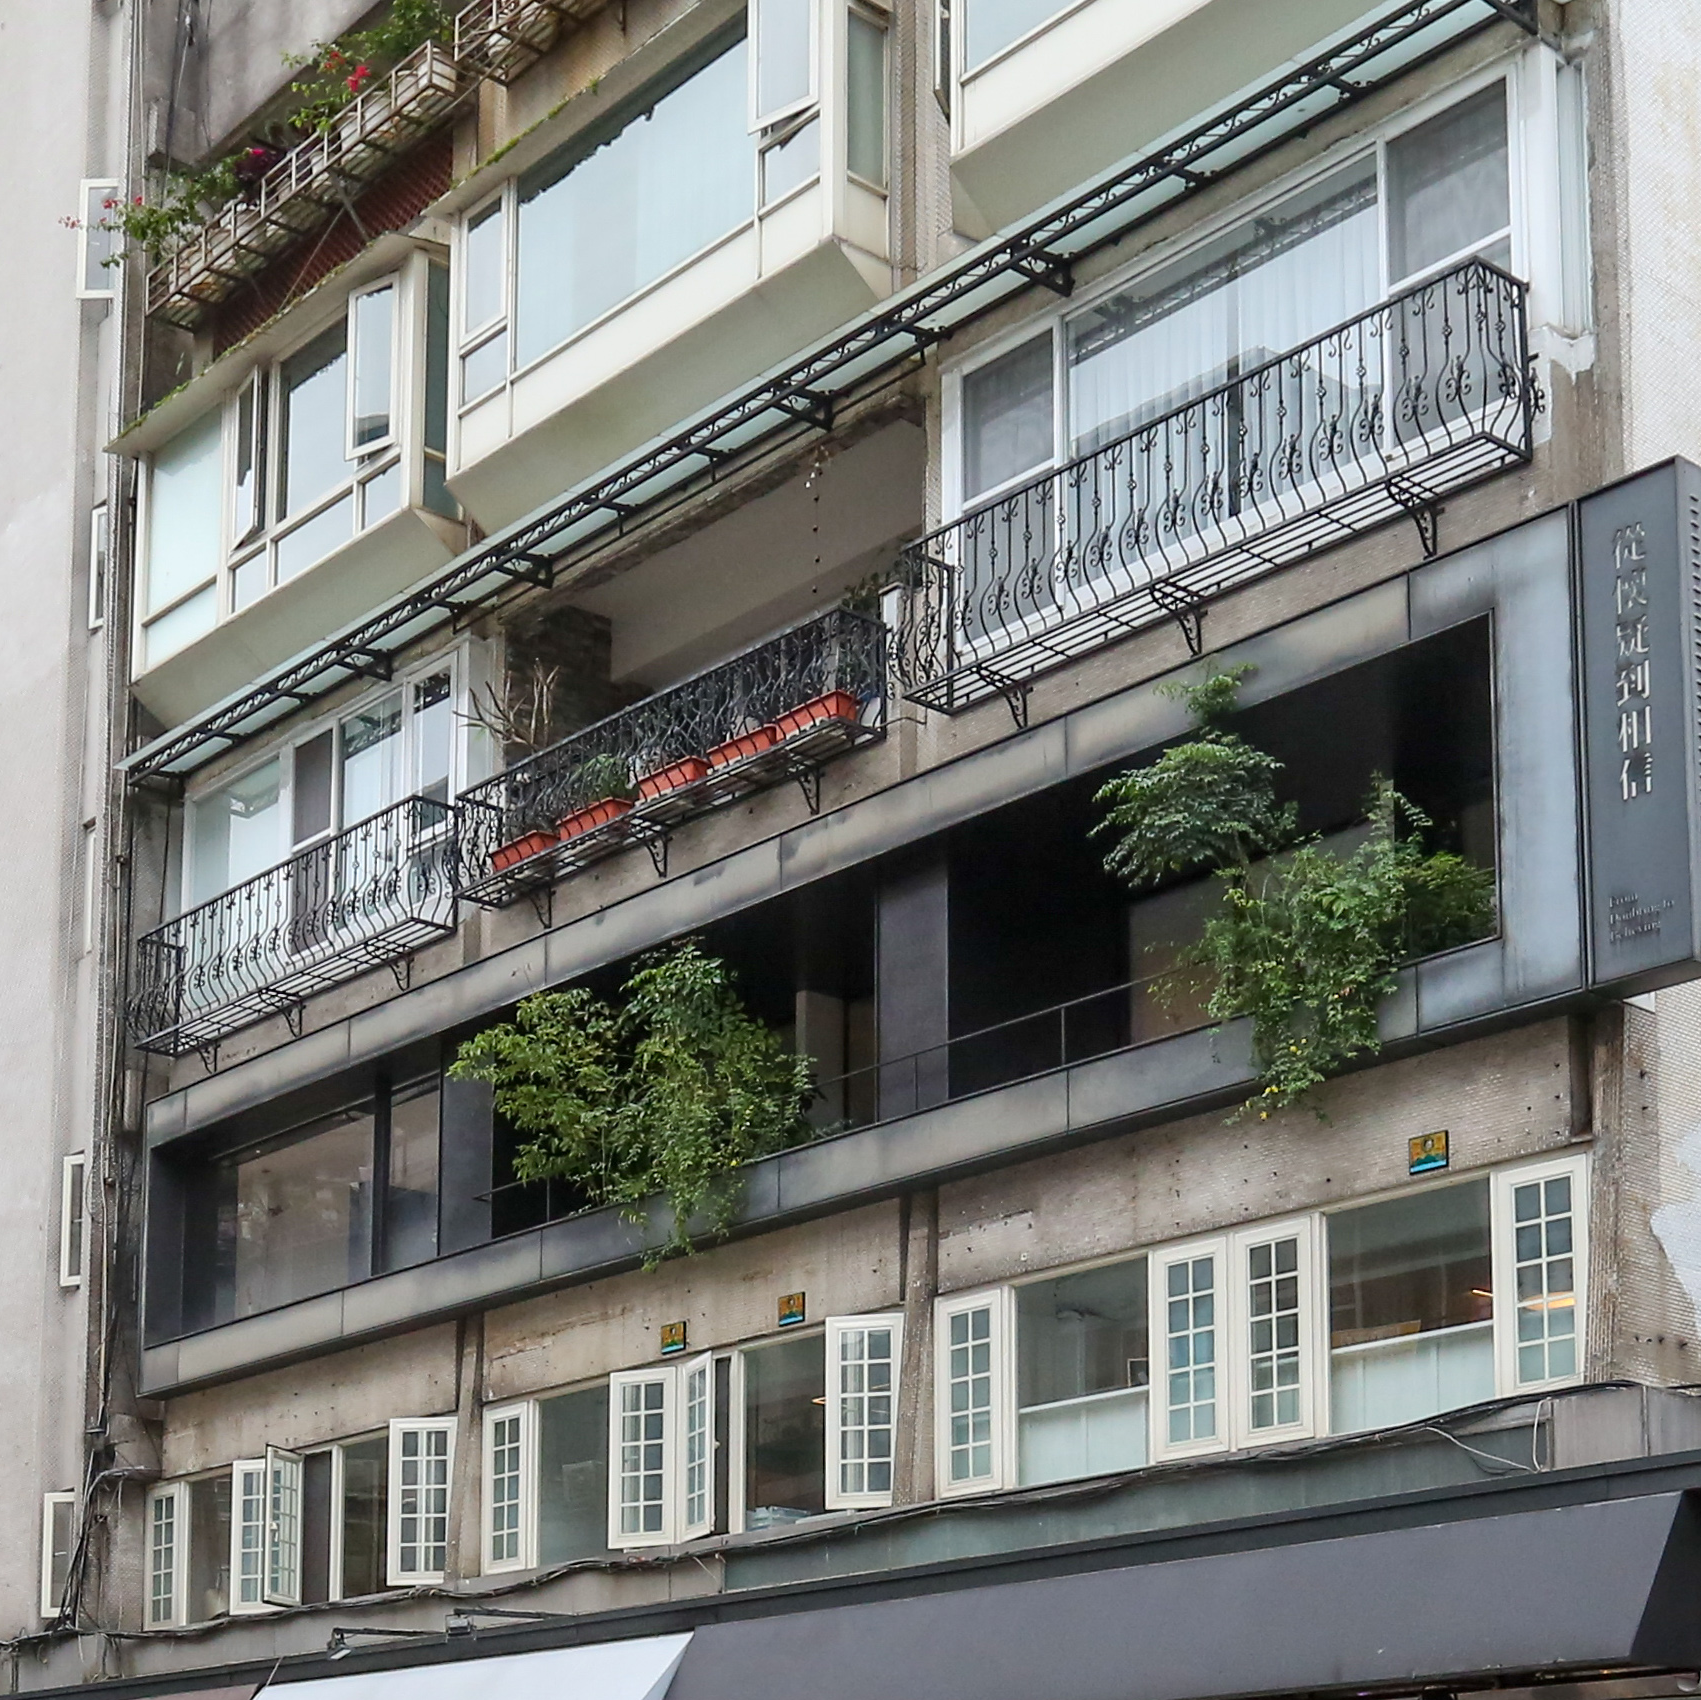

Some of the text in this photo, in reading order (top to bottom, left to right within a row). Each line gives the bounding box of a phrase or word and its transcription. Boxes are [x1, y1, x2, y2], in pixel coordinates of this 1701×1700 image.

[1612, 521, 1653, 801] 從懷疑到相信
